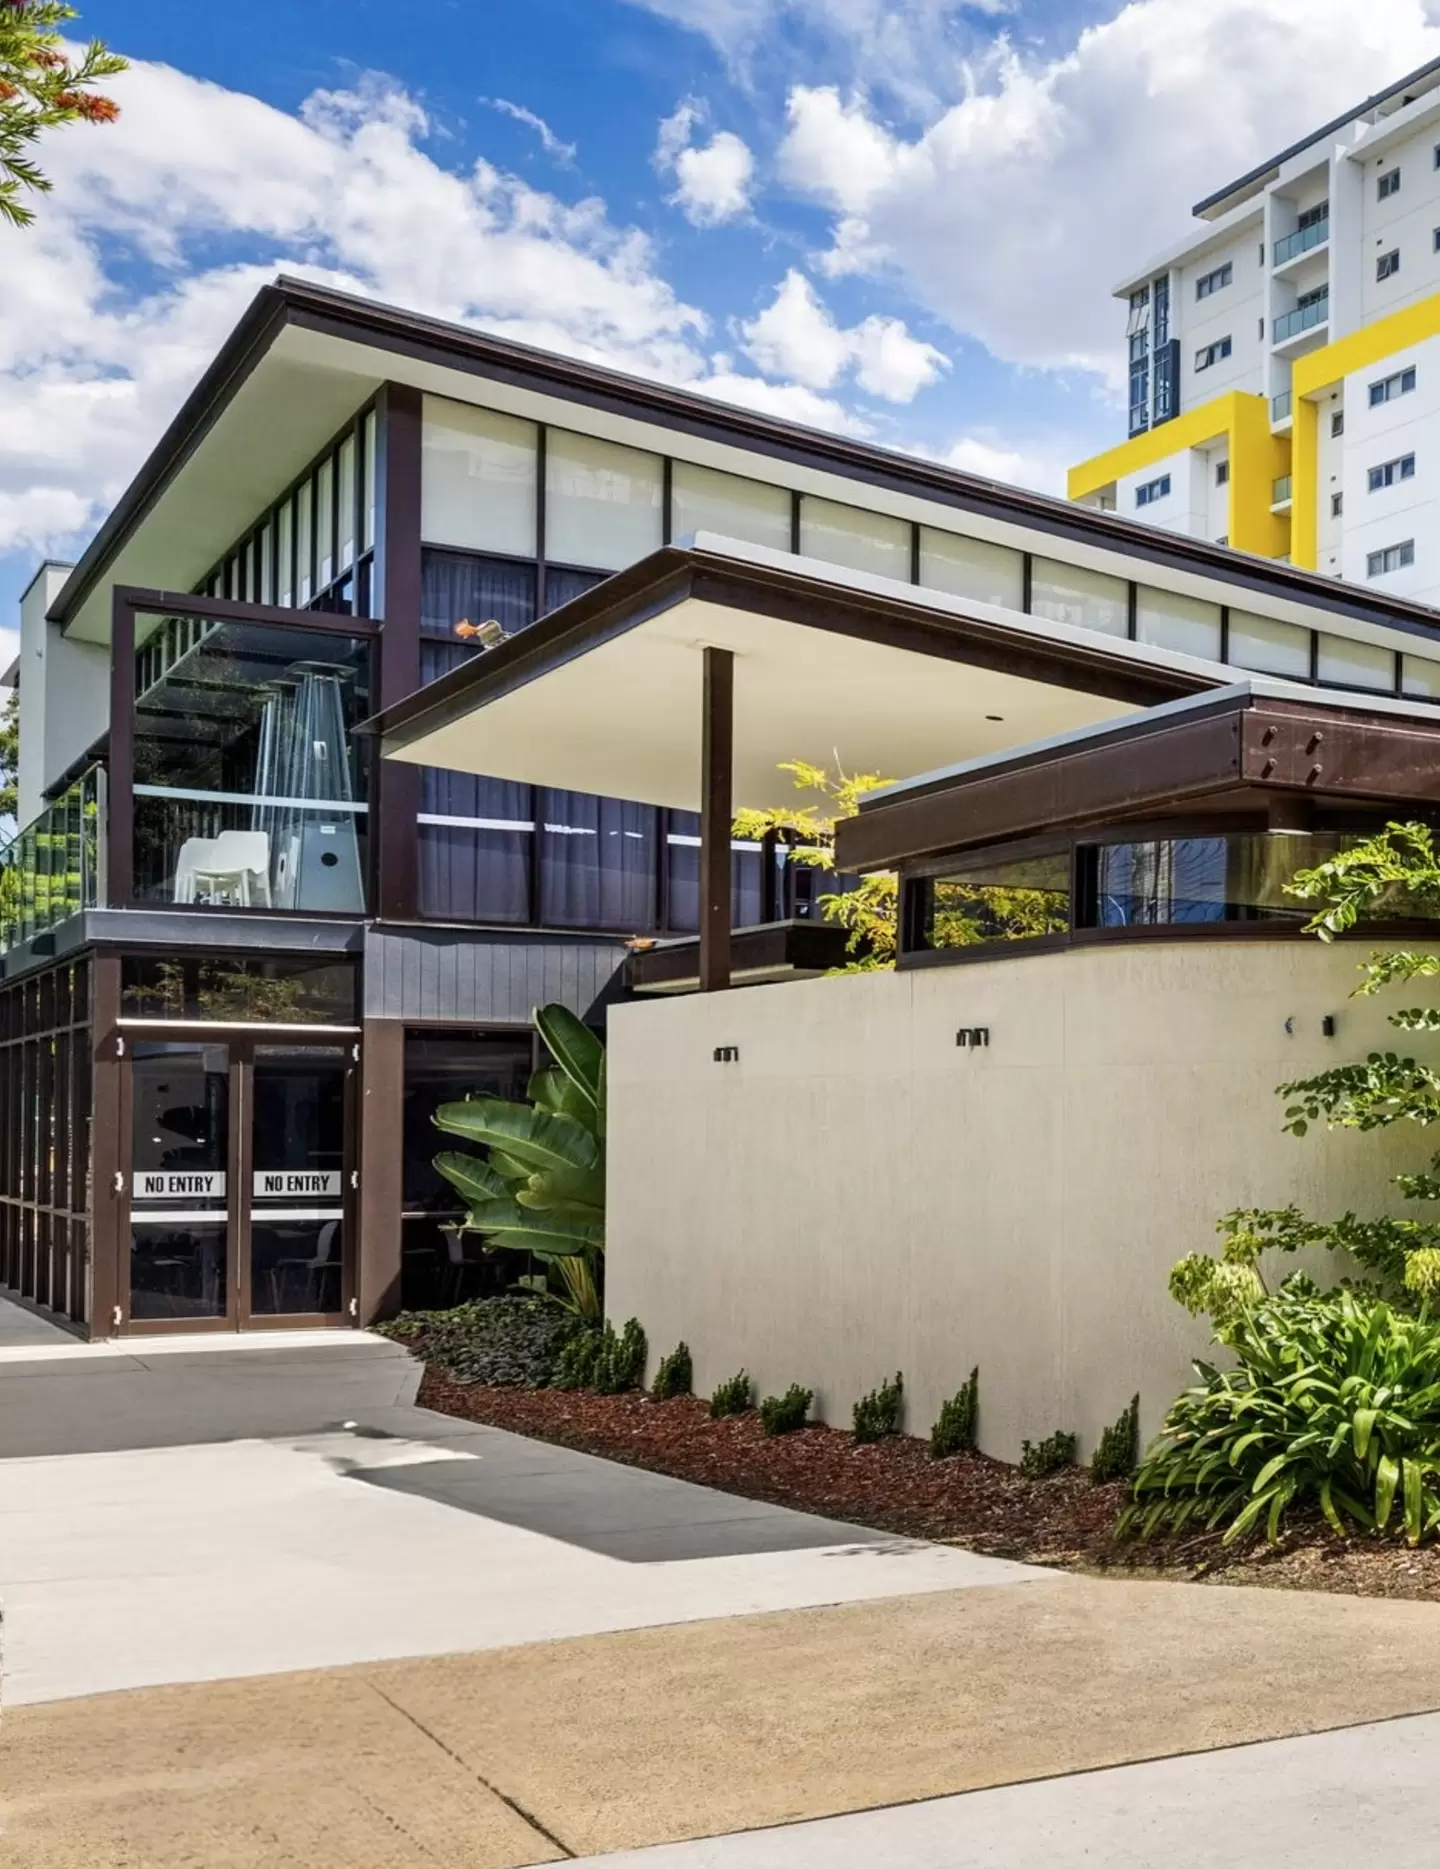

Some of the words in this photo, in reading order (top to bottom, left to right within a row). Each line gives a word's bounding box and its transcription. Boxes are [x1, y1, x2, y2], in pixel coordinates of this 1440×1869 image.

[145, 1176, 164, 1193] NO
[168, 1176, 214, 1193] ENTRY
[264, 1175, 283, 1192] NO
[286, 1175, 330, 1192] ENTRY
